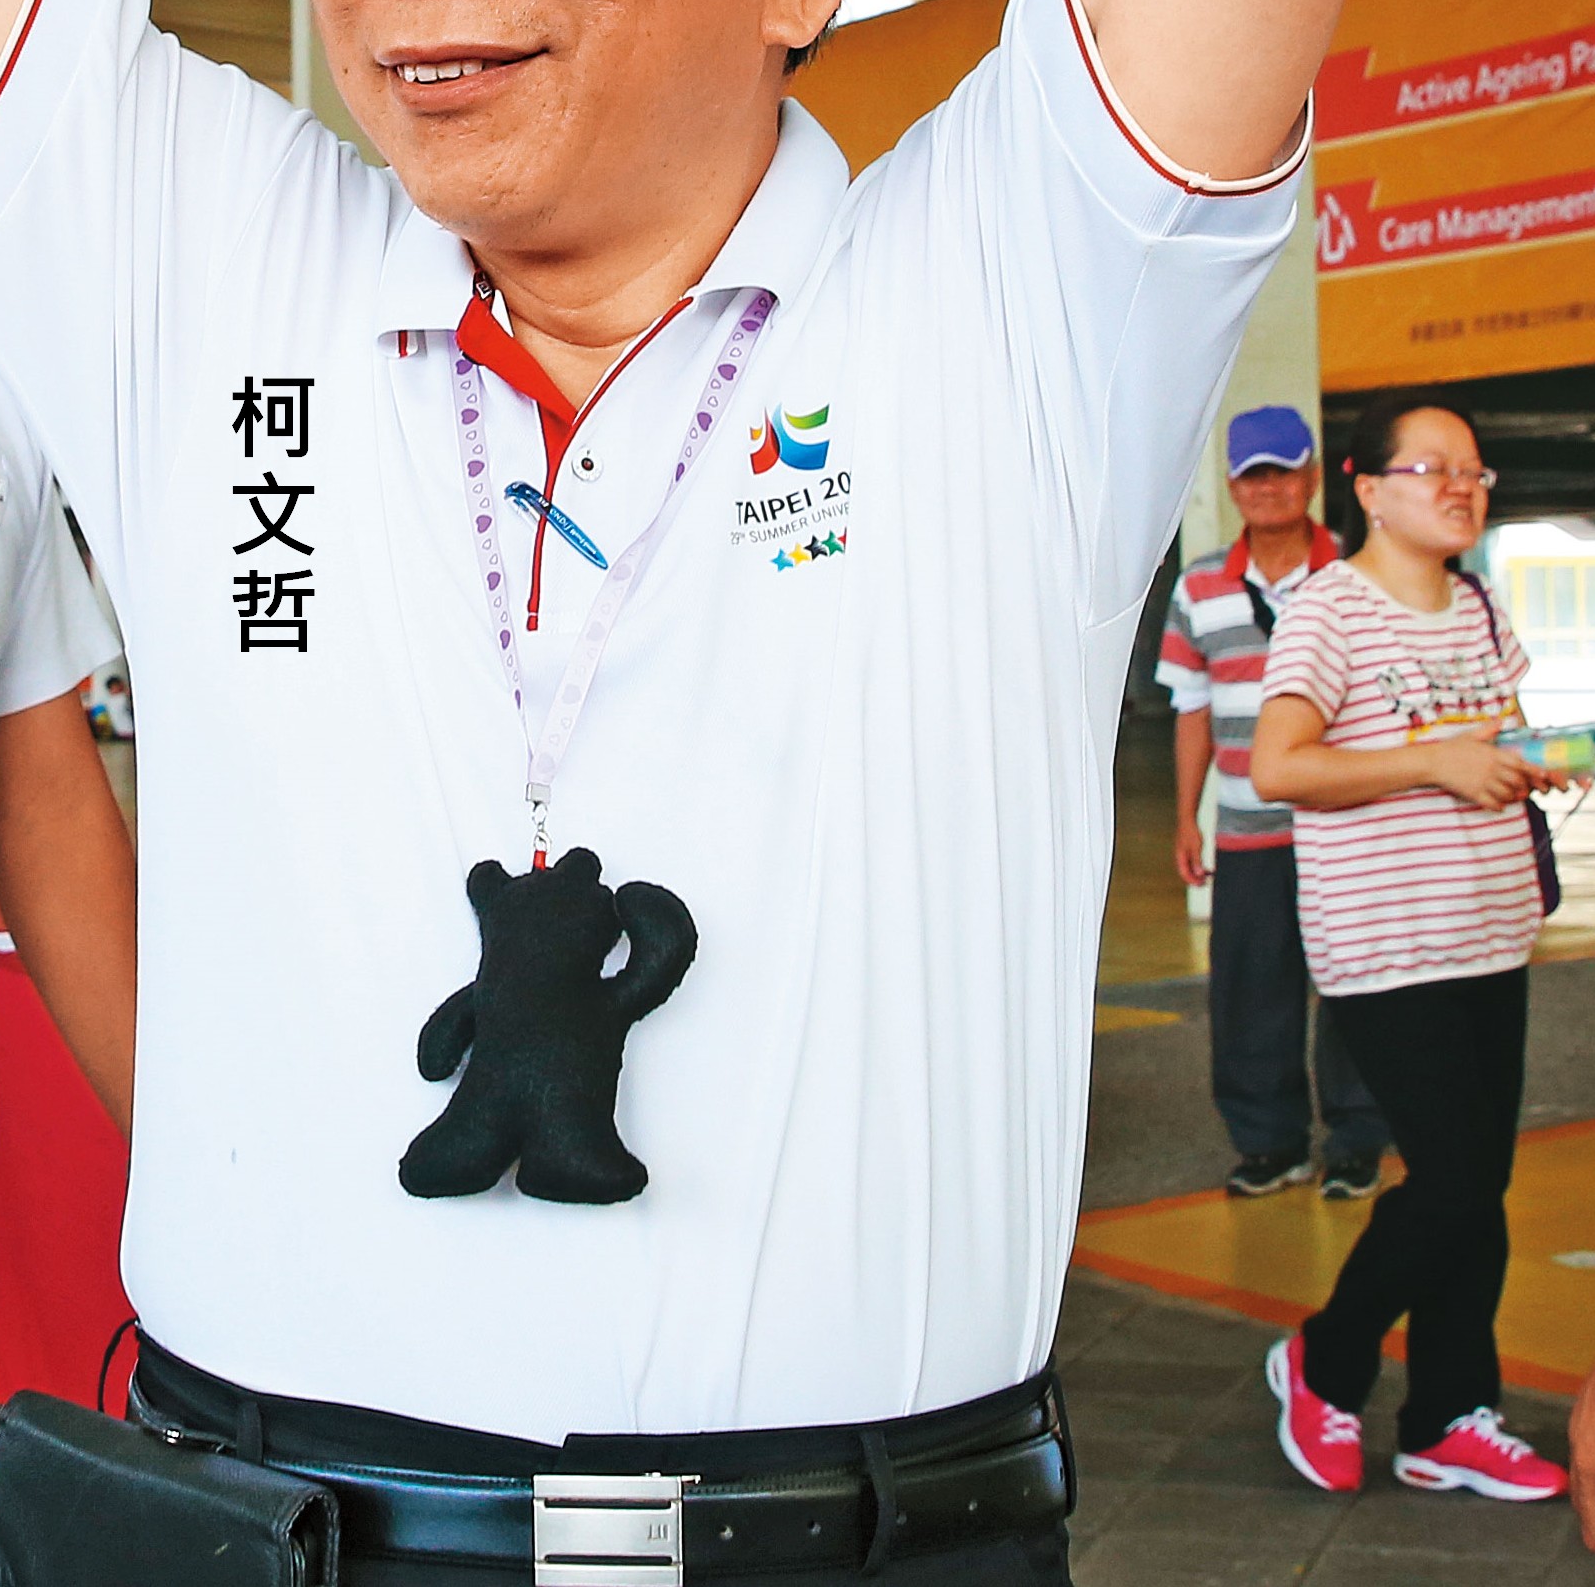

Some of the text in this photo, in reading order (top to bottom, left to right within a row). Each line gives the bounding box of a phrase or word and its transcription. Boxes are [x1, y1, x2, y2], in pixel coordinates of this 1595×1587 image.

[1396, 73, 1470, 114] Active
[1475, 52, 1566, 102] Ageing
[1378, 216, 1432, 252] Care
[735, 487, 812, 525] TAIPEI
[749, 517, 808, 543] SUMMER
